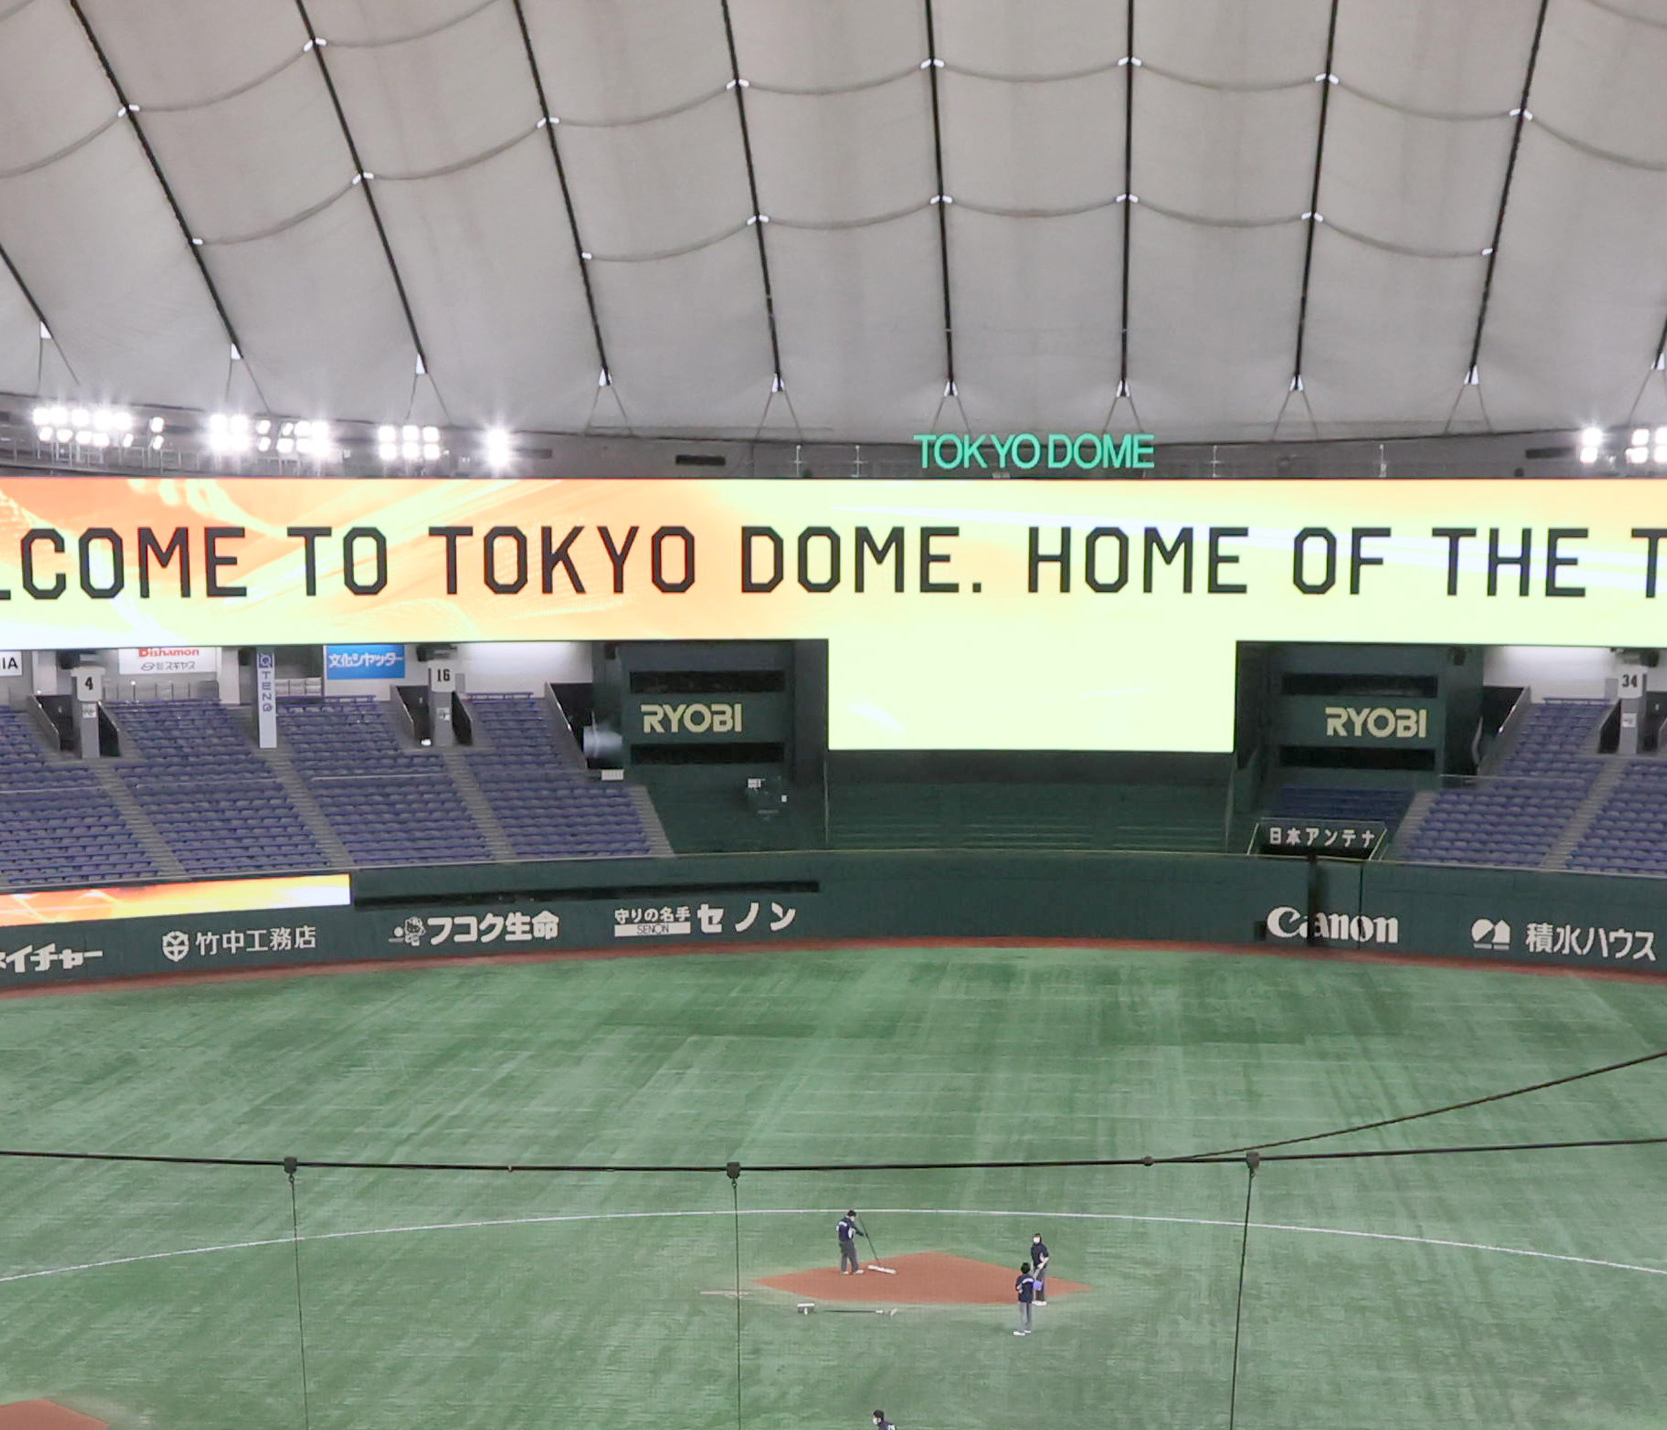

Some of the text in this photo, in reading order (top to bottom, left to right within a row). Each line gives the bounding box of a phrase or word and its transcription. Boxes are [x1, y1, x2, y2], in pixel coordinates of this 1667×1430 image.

[914, 433, 1155, 469] TOKYO DOME
[287, 526, 388, 595] TO
[430, 525, 695, 595] TOKYO
[741, 526, 983, 594] DOME.
[1028, 526, 1249, 595] HOME
[1292, 527, 1391, 596] OF
[1432, 527, 1588, 598] THE
[327, 652, 404, 667] 文化シャッター
[84, 676, 94, 690] 4
[436, 669, 451, 682] 16
[1621, 674, 1638, 688] 34
[640, 703, 743, 733] RYOBI
[1325, 707, 1427, 738] RYOBI
[1268, 826, 1375, 848] 日本アンテナ
[427, 911, 560, 945] フコク生命
[614, 906, 690, 923] 守りの名手
[697, 902, 796, 933] セノン
[1266, 906, 1399, 944] Canon
[195, 925, 316, 955] 竹中工務店
[1525, 923, 1657, 961] 積水ハウス
